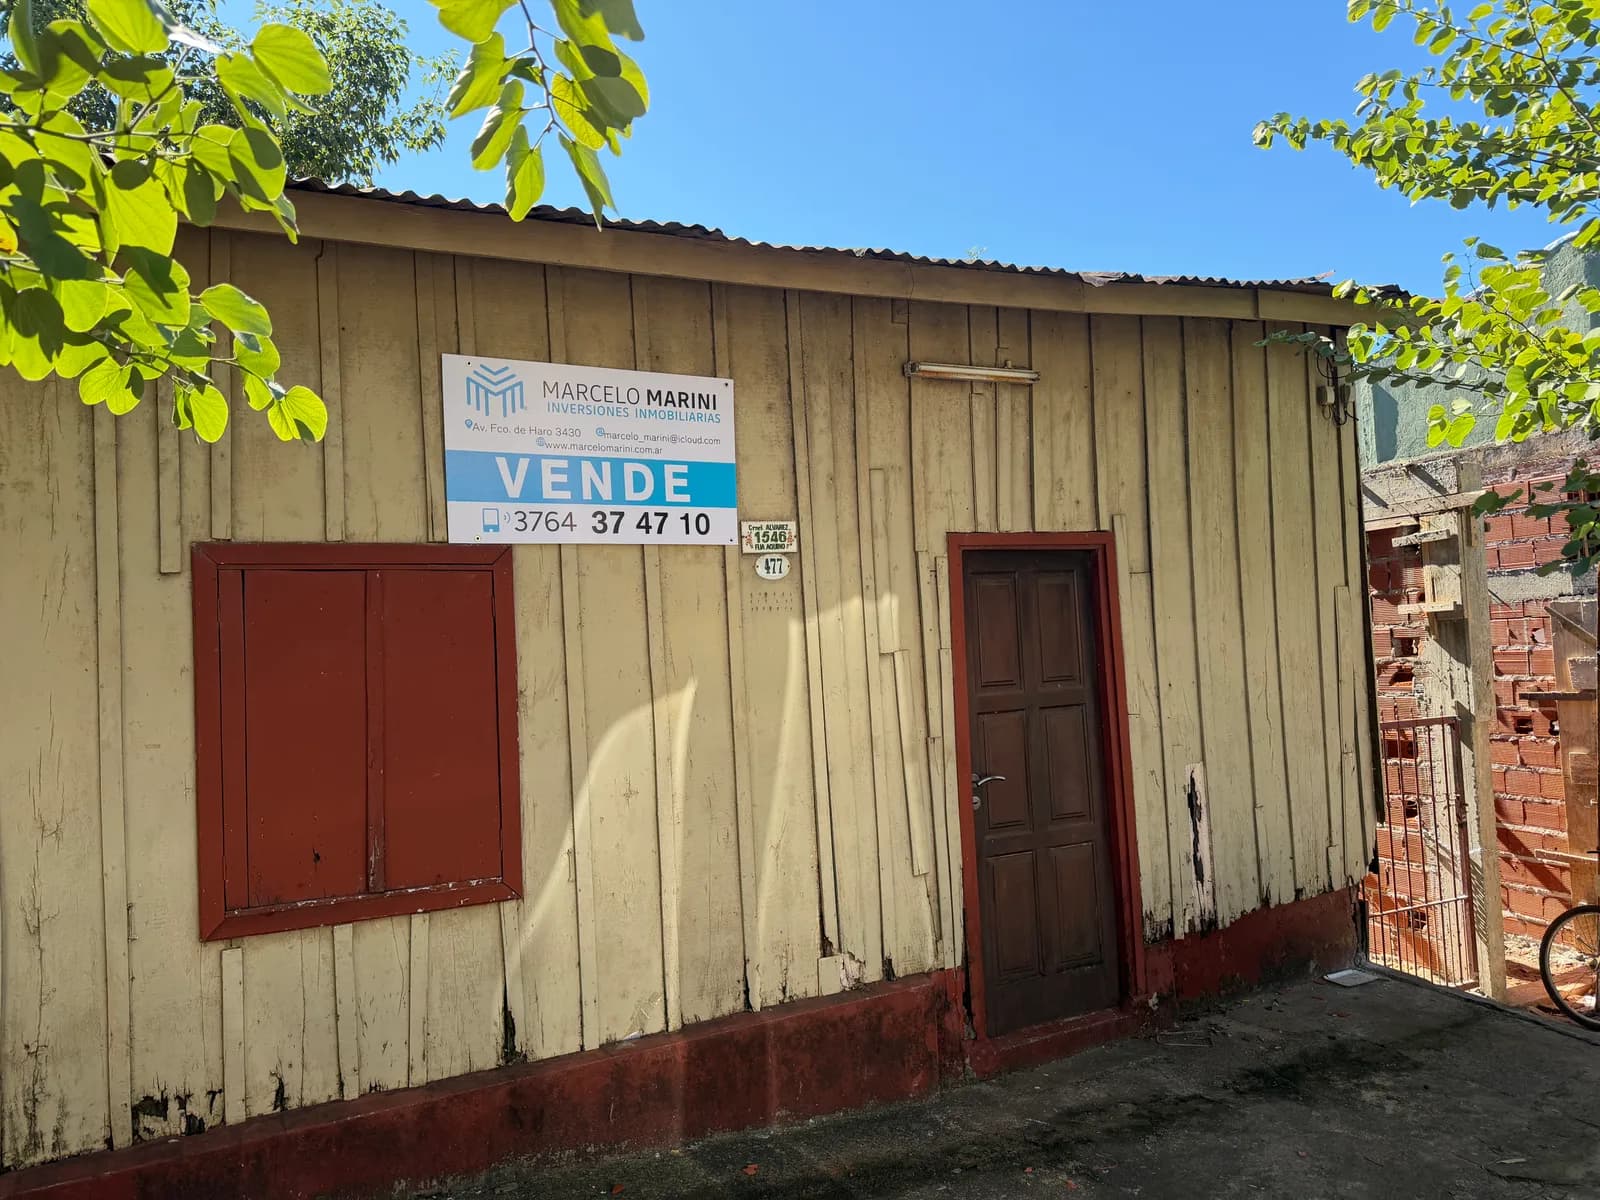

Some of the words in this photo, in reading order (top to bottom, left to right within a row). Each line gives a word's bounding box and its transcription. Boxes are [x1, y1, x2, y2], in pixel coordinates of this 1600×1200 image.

[543, 380, 640, 405] MARCELO
[646, 388, 717, 411] MARINI
[547, 402, 629, 418] INVERSIONES
[635, 407, 721, 424] INMOBILIARIAS
[472, 422, 488, 433] Av.
[490, 423, 512, 434] Fco.
[513, 426, 526, 435] de
[529, 426, 553, 437] Haro
[555, 428, 582, 438] 3430
[544, 442, 663, 455] www.marcelomarini.com.ar
[495, 456, 691, 503] VENDE
[514, 510, 578, 532] 3764
[591, 510, 625, 534] 37
[636, 511, 669, 535] 47
[679, 512, 711, 535] 10
[754, 531, 787, 544] 1546
[764, 558, 783, 574] 477
